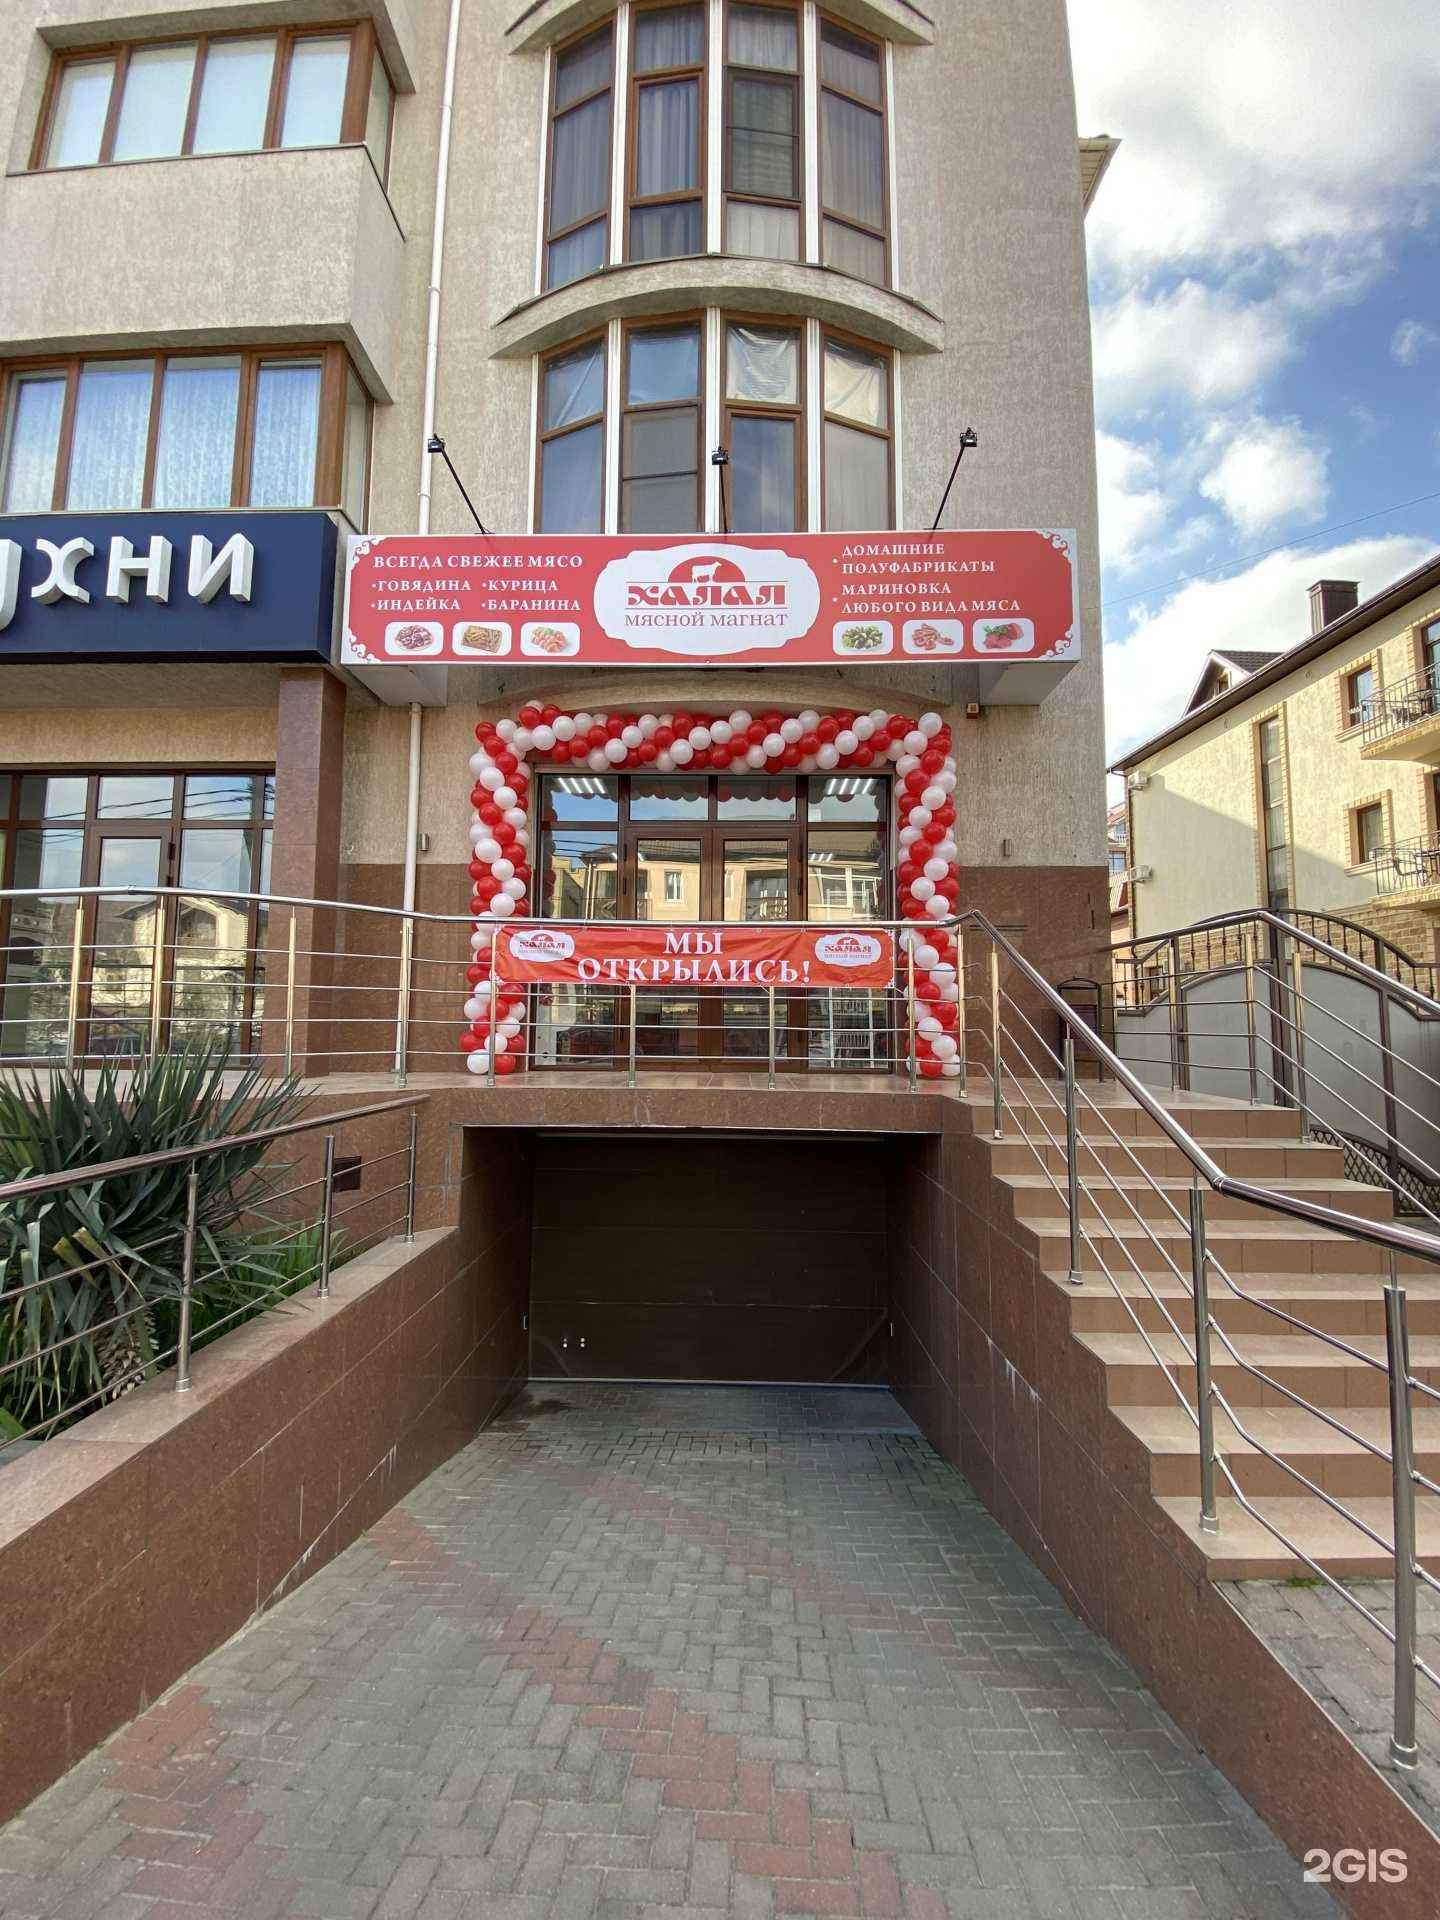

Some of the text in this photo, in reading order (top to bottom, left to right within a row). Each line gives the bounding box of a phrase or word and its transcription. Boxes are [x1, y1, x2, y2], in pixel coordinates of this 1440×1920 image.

[842, 543, 945, 559] ДОМАШНИЕ
[373, 555, 583, 570] ВСЕГДА СВЕЖЕЕ МЯСО
[842, 560, 995, 575] ПОЛУФАБРИКАТЫ
[376, 580, 559, 593] ГОВЯДИНА КУРИЦА
[842, 582, 952, 596] МАРИНОВКА
[628, 585, 786, 606] ХАЛАЛ
[375, 597, 581, 612] ИНДЕЙКА БАРАНИНА
[841, 599, 1021, 614] ЛЮБОГО ВИДА МЯСА
[663, 932, 723, 955] МЫ
[577, 958, 810, 983] ОТКРЫЛИСЬ!
